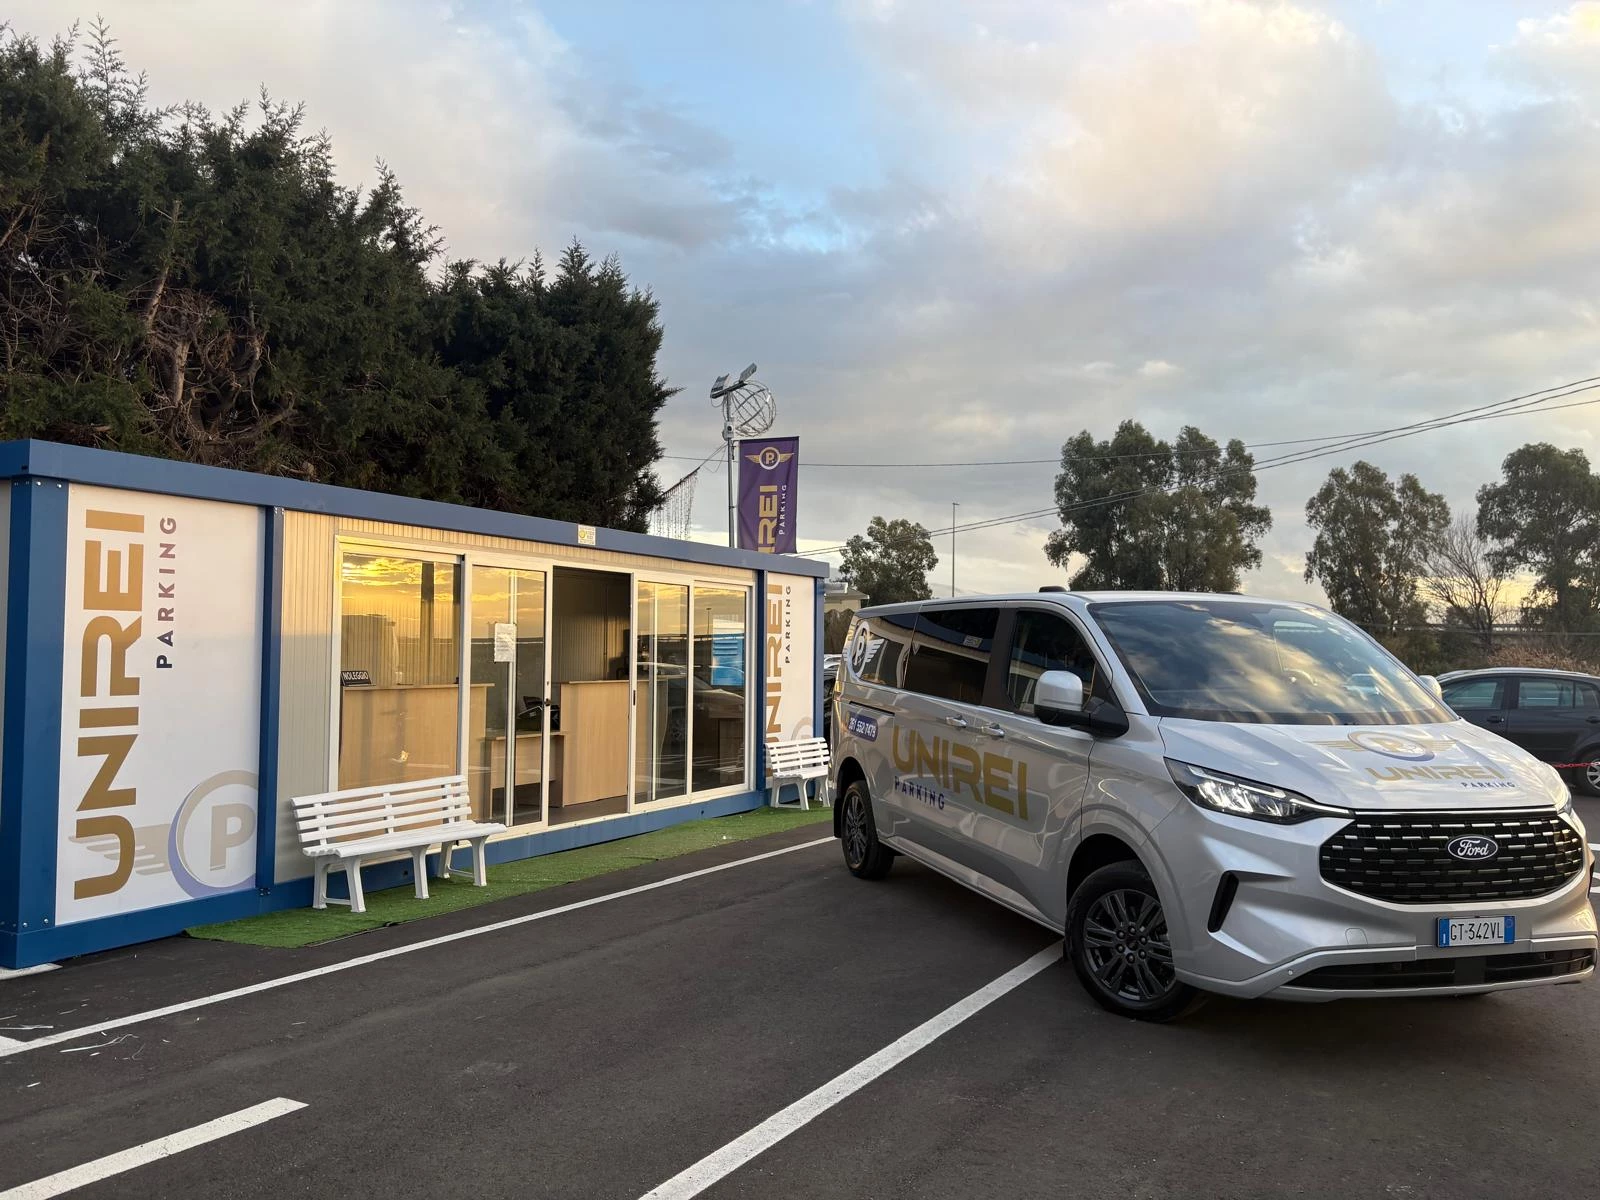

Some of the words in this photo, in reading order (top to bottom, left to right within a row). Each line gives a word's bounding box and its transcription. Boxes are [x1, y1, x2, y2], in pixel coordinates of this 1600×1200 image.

[758, 485, 777, 554] IREI
[778, 485, 787, 535] PARKING
[156, 516, 177, 669] PARKING
[342, 671, 369, 681] NOLEGGIO
[74, 509, 145, 900] UNIREI
[892, 725, 1028, 820] UNIREI
[895, 776, 945, 809] PARKING
[1365, 766, 1505, 781] UNIREI
[1457, 839, 1489, 856] Ford
